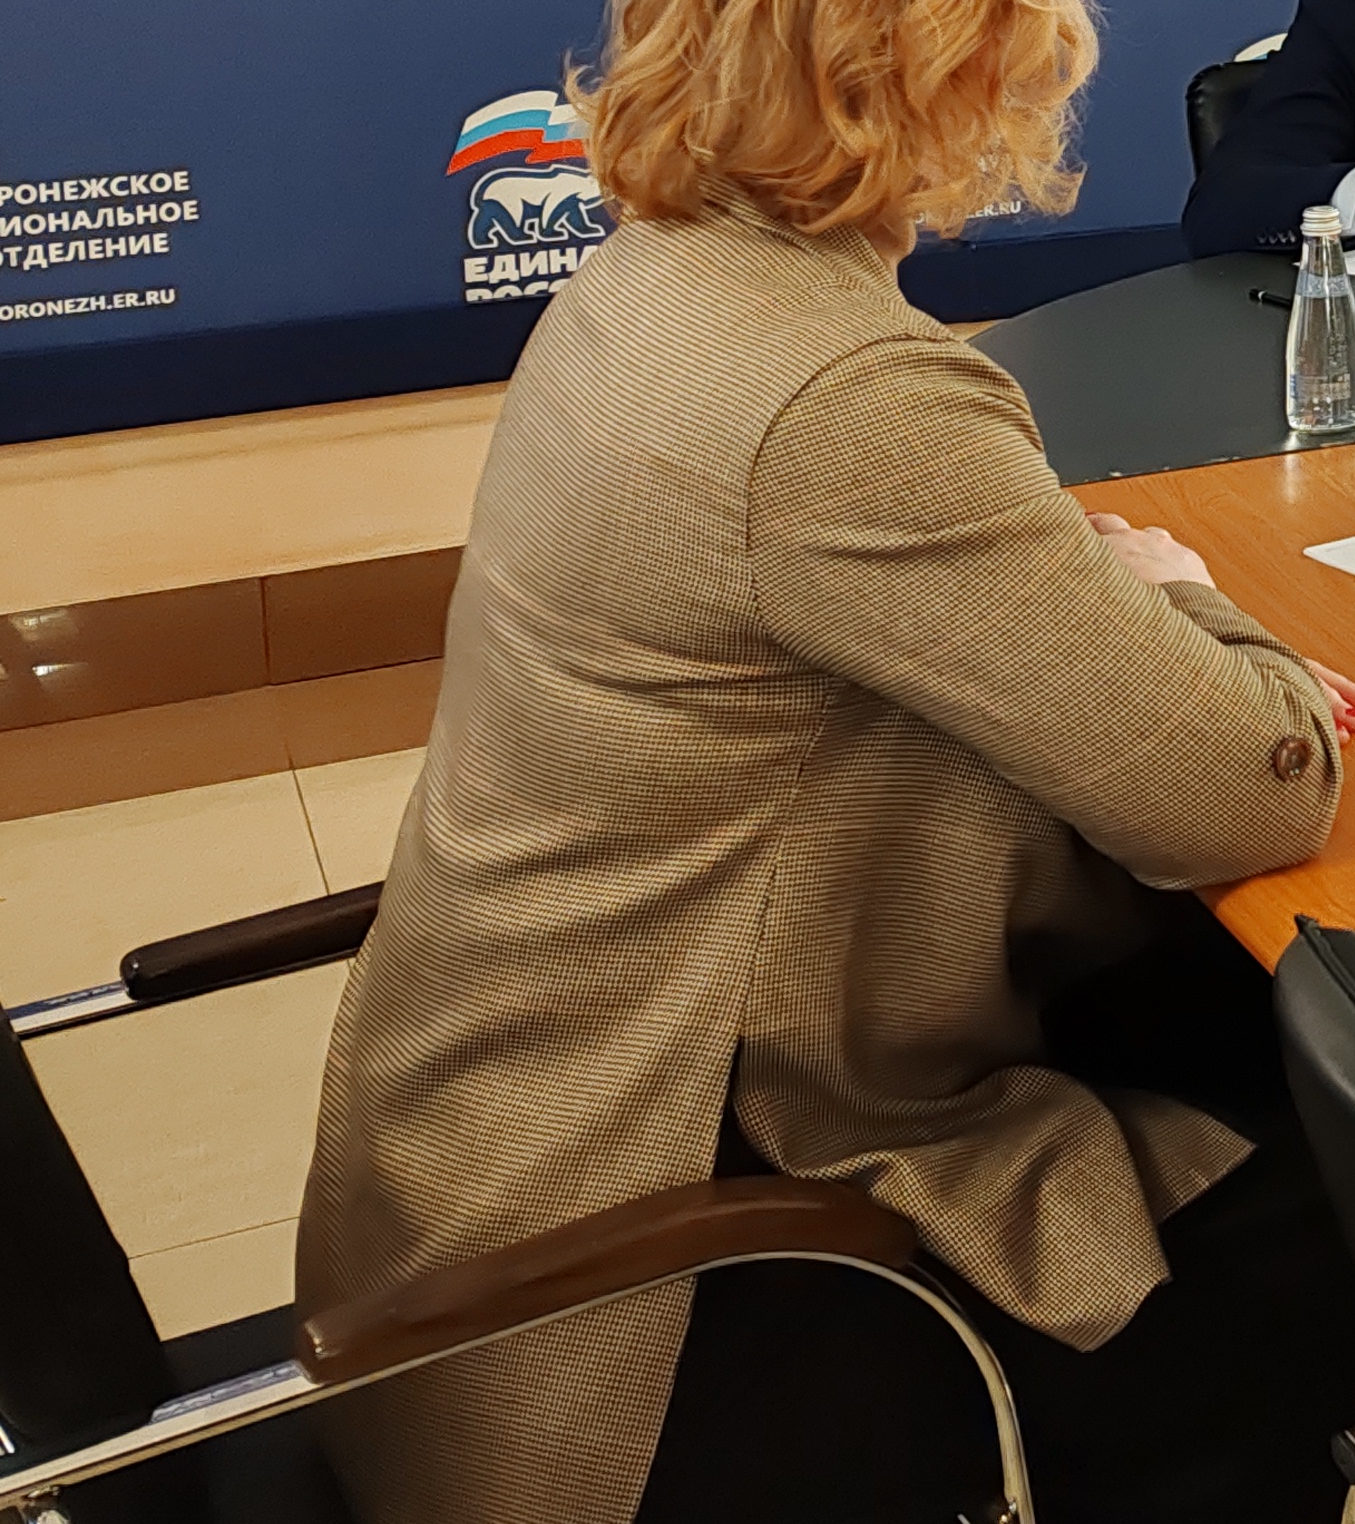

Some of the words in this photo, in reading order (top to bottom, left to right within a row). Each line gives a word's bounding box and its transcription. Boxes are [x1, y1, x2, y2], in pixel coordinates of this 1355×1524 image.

[0, 170, 190, 207] РОНЕЖСКОЕ
[0, 199, 200, 238] ИОНАЛЬНОЕ
[0, 232, 170, 271] ТДЕЛЕНИЕ
[463, 245, 599, 284] ЕДИН
[0, 288, 176, 321] ORONEZH.ER.RU
